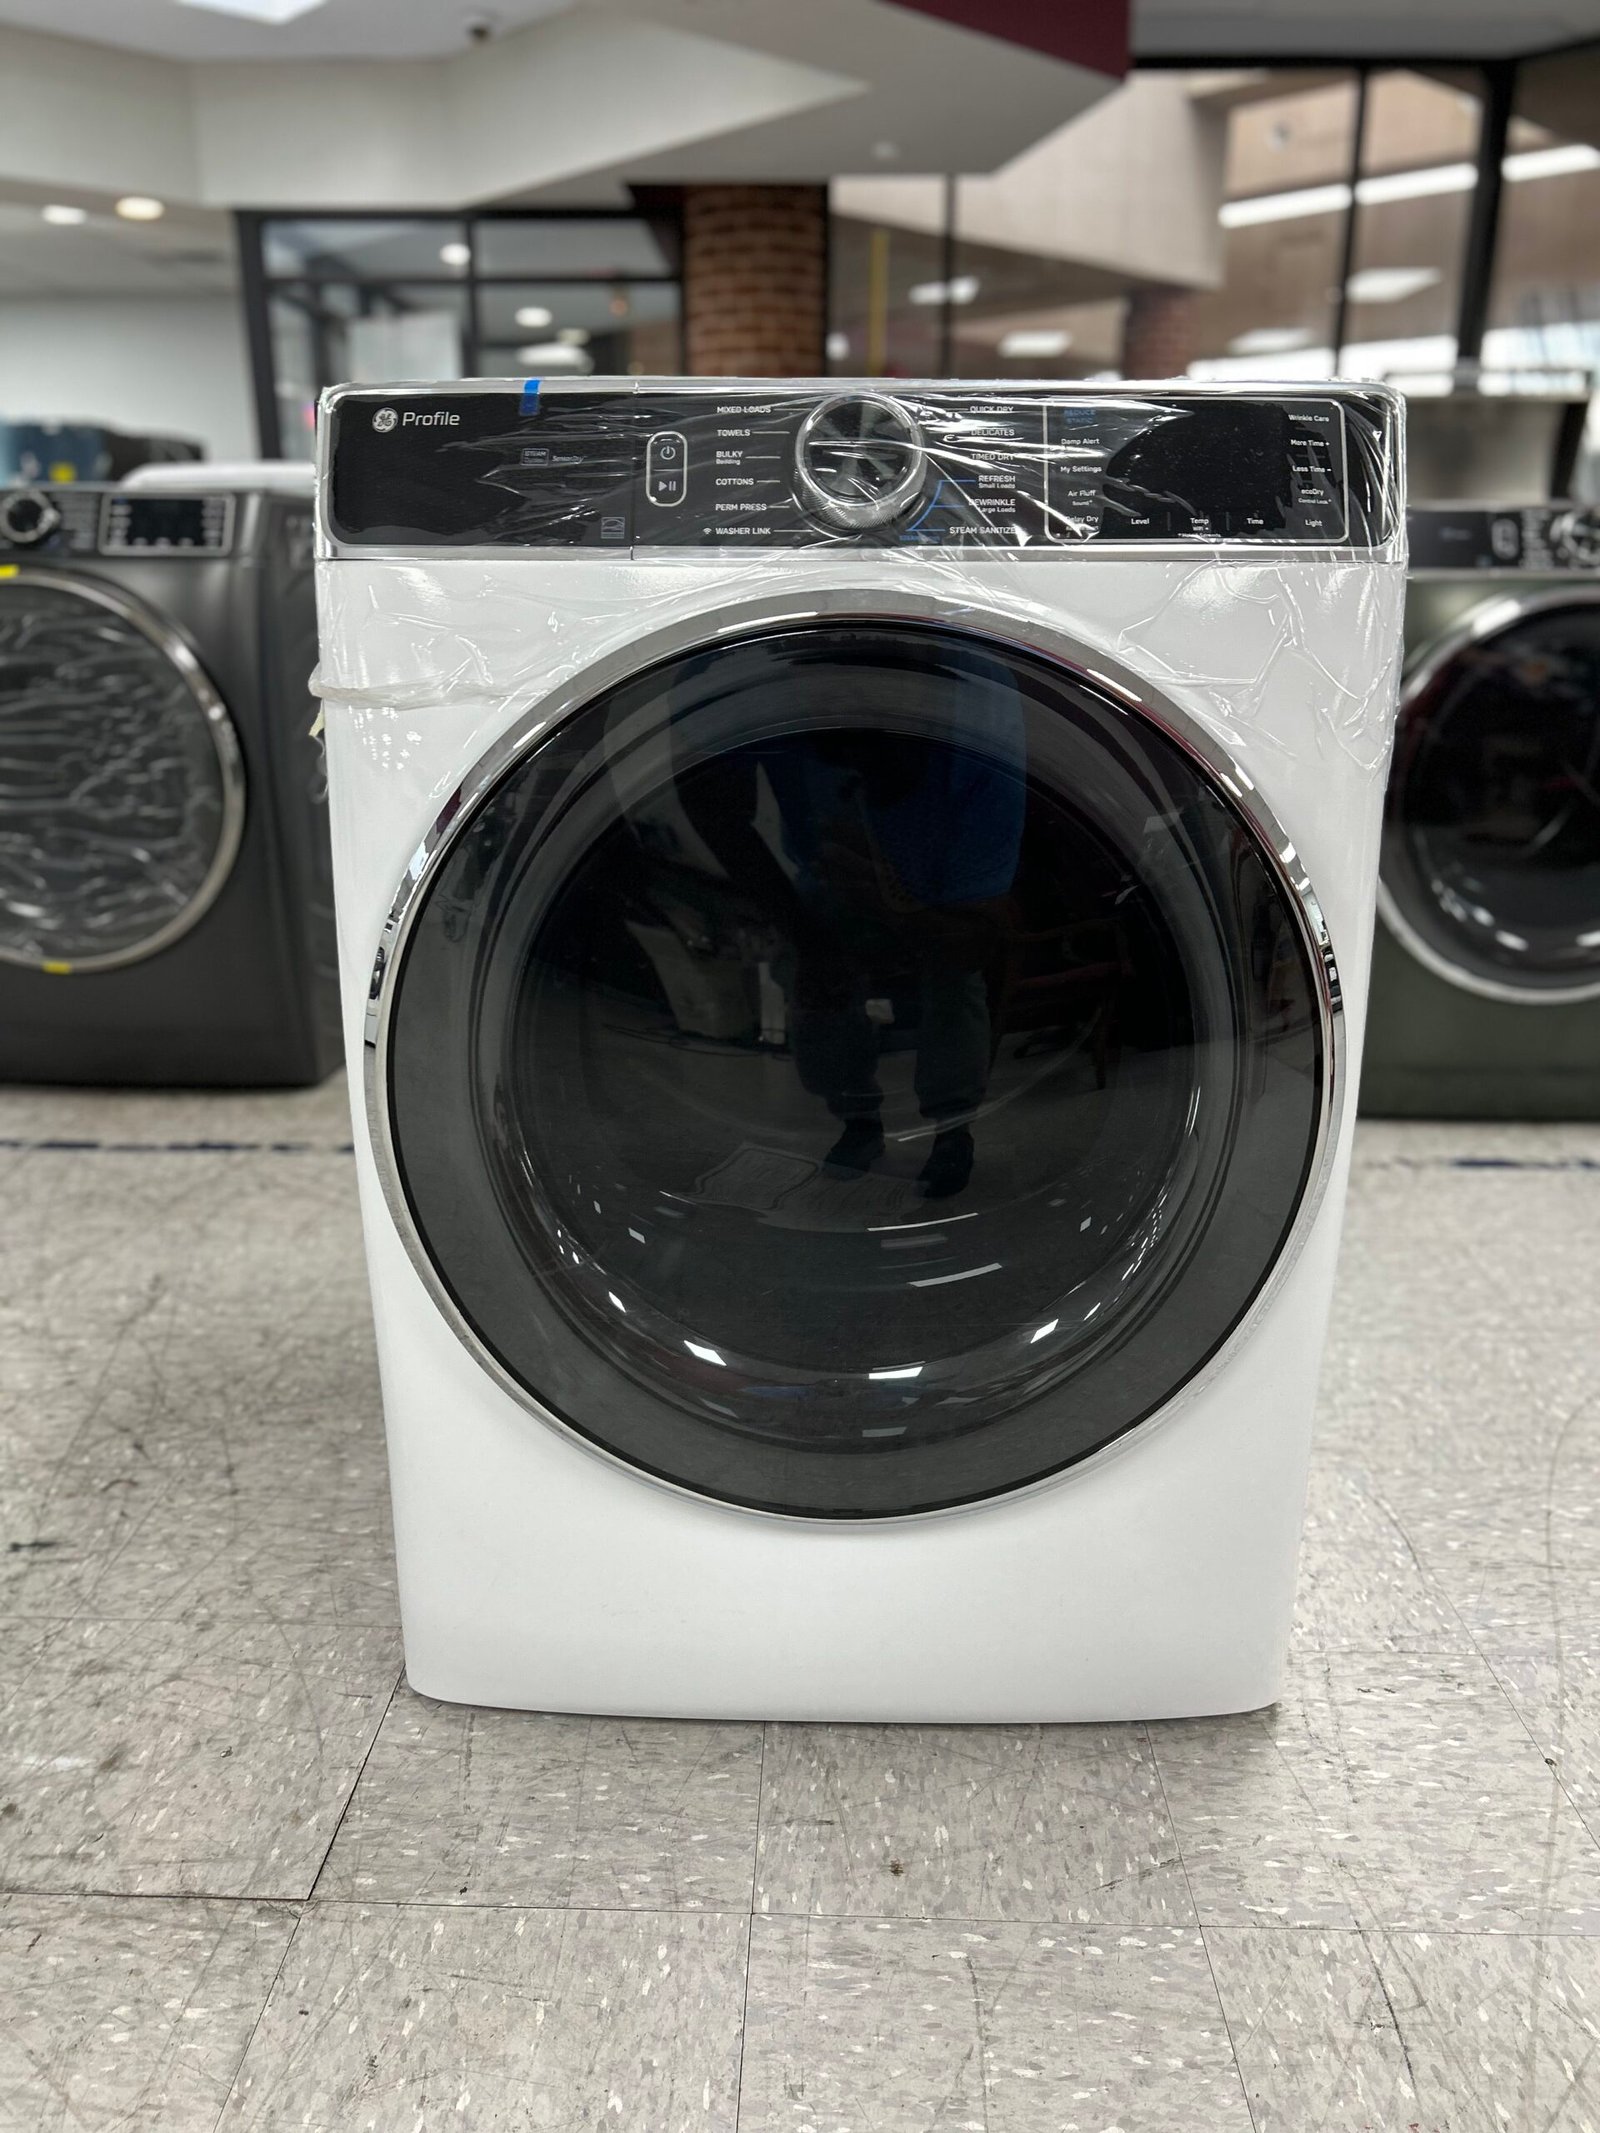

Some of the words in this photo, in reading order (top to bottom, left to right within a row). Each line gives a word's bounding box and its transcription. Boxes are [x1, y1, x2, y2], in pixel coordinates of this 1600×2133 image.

[717, 406, 742, 414] MIXED
[744, 406, 771, 414] LOADS
[402, 412, 460, 426] Profile
[1288, 414, 1313, 422] Wrinkle
[1314, 414, 1330, 422] Care
[717, 429, 750, 437] TOWELS
[1061, 438, 1081, 446] Damp
[1308, 439, 1325, 447] Time
[716, 451, 743, 459] BULKY
[971, 453, 996, 461] TIMED
[997, 453, 1015, 461] DRY
[1060, 466, 1071, 474] My
[1072, 465, 1102, 474] Settings
[1309, 465, 1326, 473] Time
[716, 478, 754, 486] COTTONS
[1079, 489, 1096, 497] Fluff
[1301, 488, 1324, 496] ecoDry
[969, 498, 1016, 506] DEWRINKLE
[716, 503, 736, 511] PERM
[738, 503, 767, 511] PRESS
[1086, 515, 1099, 523] Dry
[1131, 517, 1150, 525] Level
[1190, 517, 1209, 525] Temp
[1247, 517, 1264, 525] Time
[1305, 519, 1323, 527] Light
[716, 527, 748, 535] WASHER
[750, 527, 771, 535] LINK
